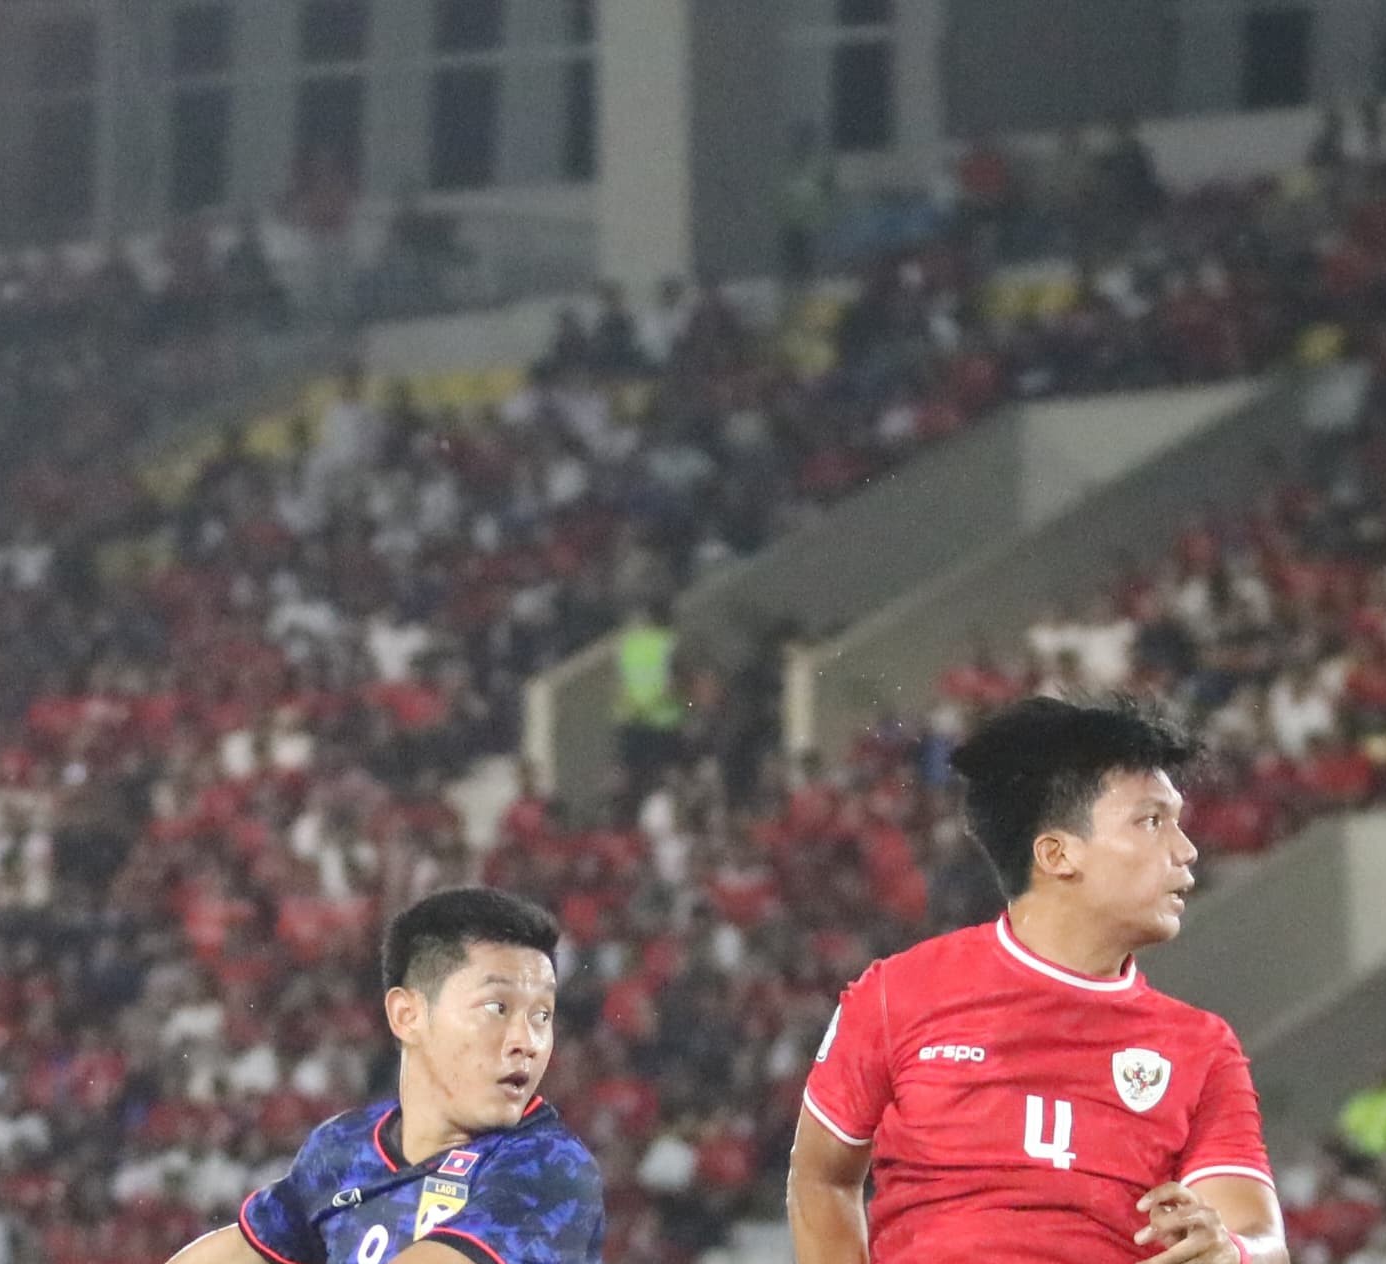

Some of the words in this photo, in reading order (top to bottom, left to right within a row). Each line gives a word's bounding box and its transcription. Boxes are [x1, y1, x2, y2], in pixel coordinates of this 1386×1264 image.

[918, 1044, 986, 1063] erspo
[1023, 1094, 1076, 1168] 4
[435, 1183, 457, 1196] LAOS
